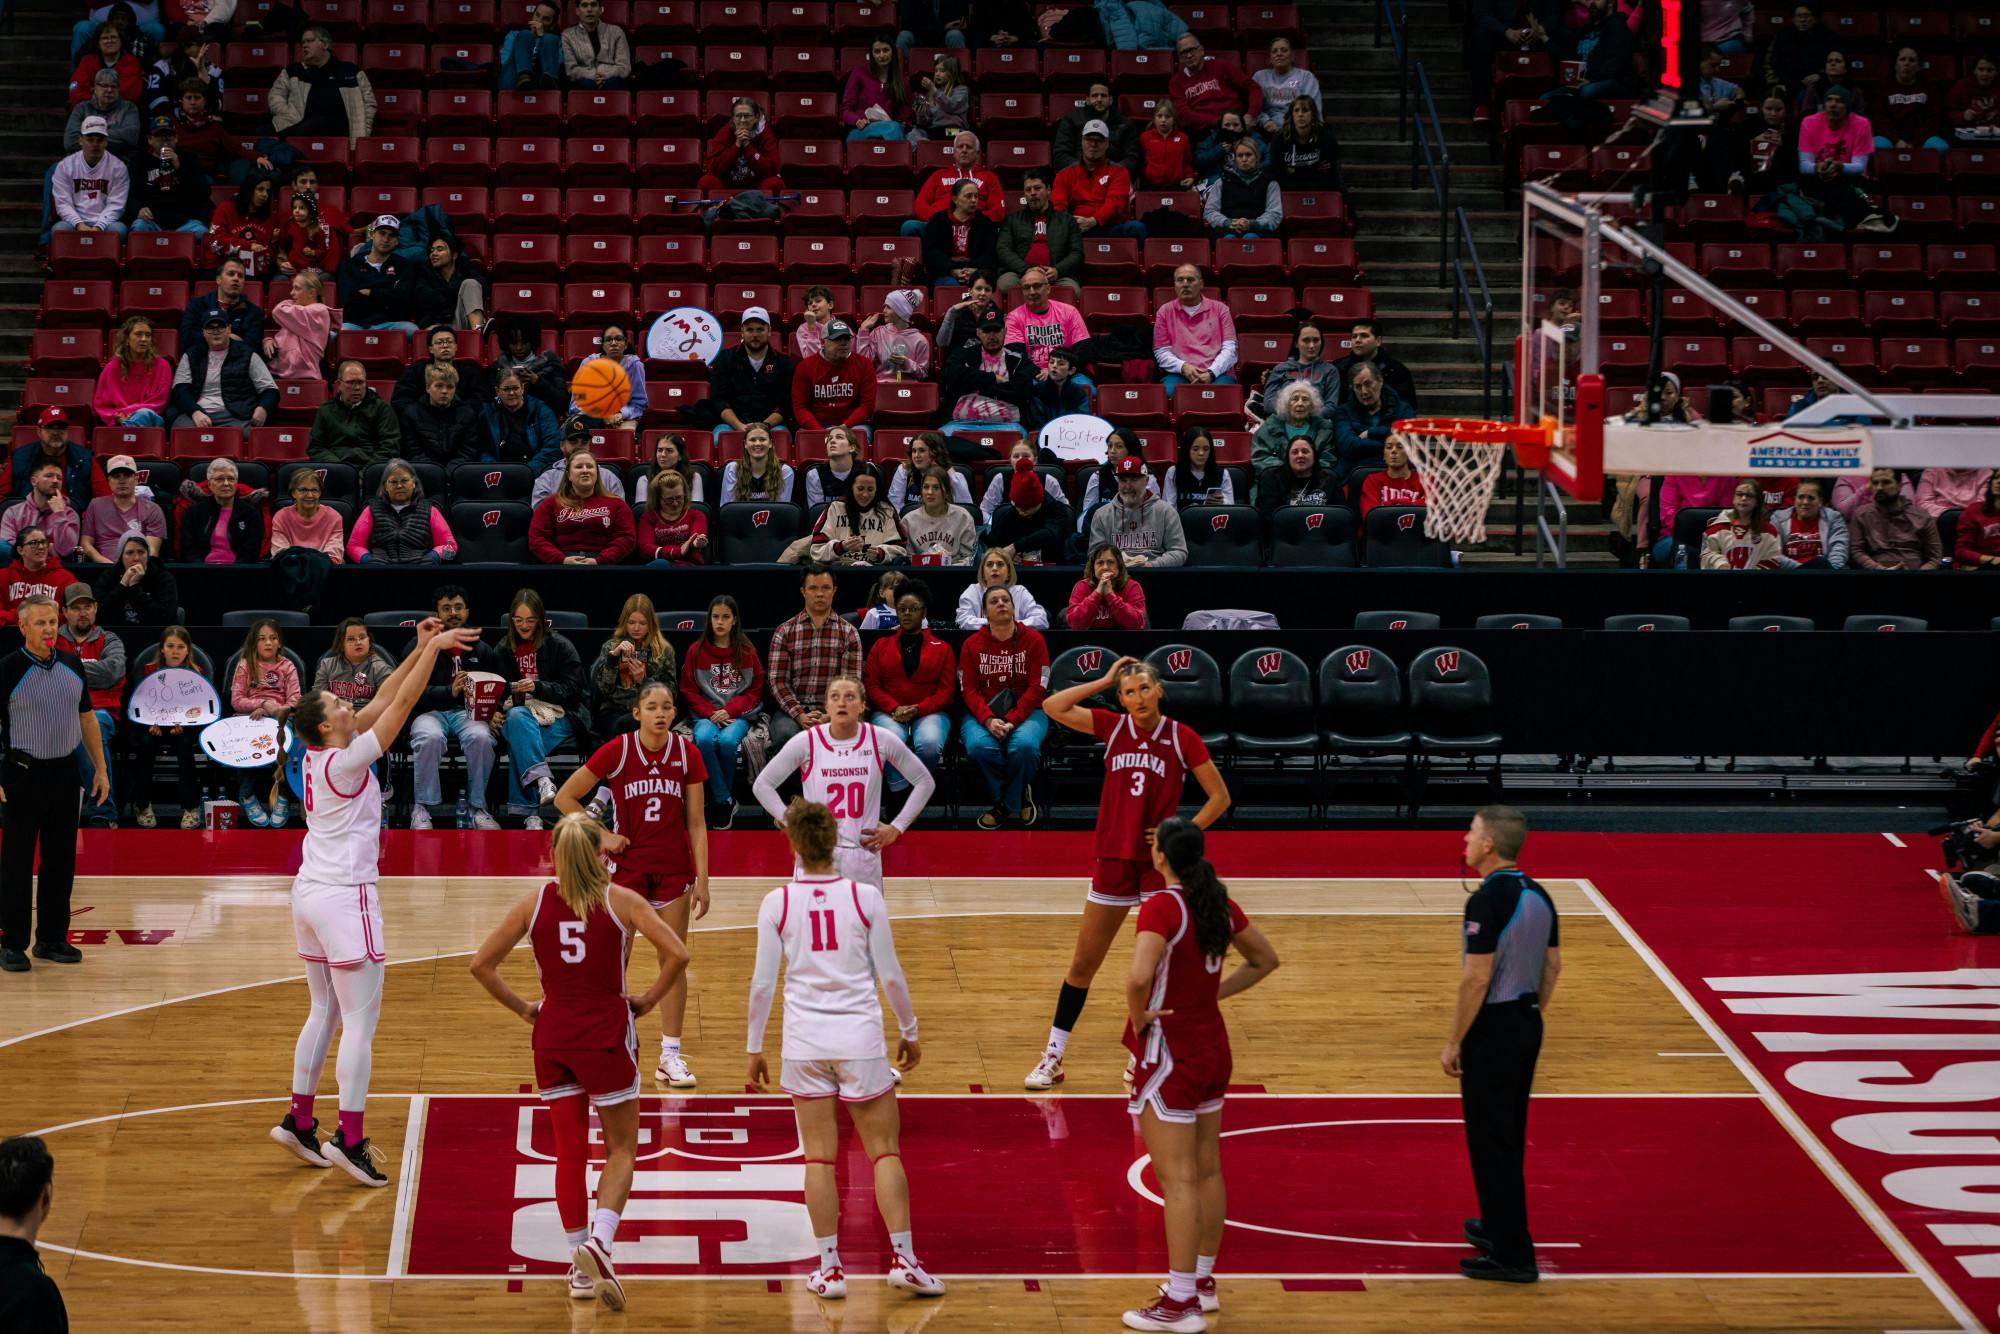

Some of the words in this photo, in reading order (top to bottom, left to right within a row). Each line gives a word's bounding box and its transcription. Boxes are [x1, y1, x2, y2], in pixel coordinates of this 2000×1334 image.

[73, 179, 109, 194] WISCONSIN
[88, 192, 98, 200] W
[1026, 323, 1062, 337] TOUGH
[1028, 333, 1064, 346] ENOUGH
[814, 383, 854, 399] BADGERS
[1059, 427, 1105, 443] Porter
[1750, 446, 1812, 457] AMERICAN
[1816, 447, 1860, 457] FAMILY
[1757, 459, 1852, 468] INSURANCE
[484, 471, 502, 489] W
[482, 510, 501, 528] W
[557, 506, 610, 523] Indiana
[752, 510, 770, 528] W
[836, 514, 884, 532] INANA
[1211, 515, 1229, 532] W
[1306, 514, 1324, 531] W
[1398, 514, 1416, 532] W
[916, 531, 955, 547] INDIANA
[1112, 531, 1157, 548] INDIANA
[921, 556, 931, 566] W
[8, 581, 58, 602] WISCONSIN
[979, 650, 1027, 665] WISCONSIN
[1077, 650, 1102, 675] W
[1167, 649, 1192, 674] W
[1257, 652, 1282, 677] W
[1346, 650, 1371, 675] W
[1435, 649, 1460, 674] W
[483, 682, 496, 693] W
[821, 766, 869, 778] WISCONSIN
[1112, 752, 1166, 778] INDIANA
[303, 773, 314, 811] 6
[624, 778, 682, 800] INDIANA
[1130, 771, 1146, 796] 3
[827, 781, 865, 819] 20
[644, 797, 661, 822] 2
[809, 910, 839, 951] 11
[558, 921, 586, 964] 5
